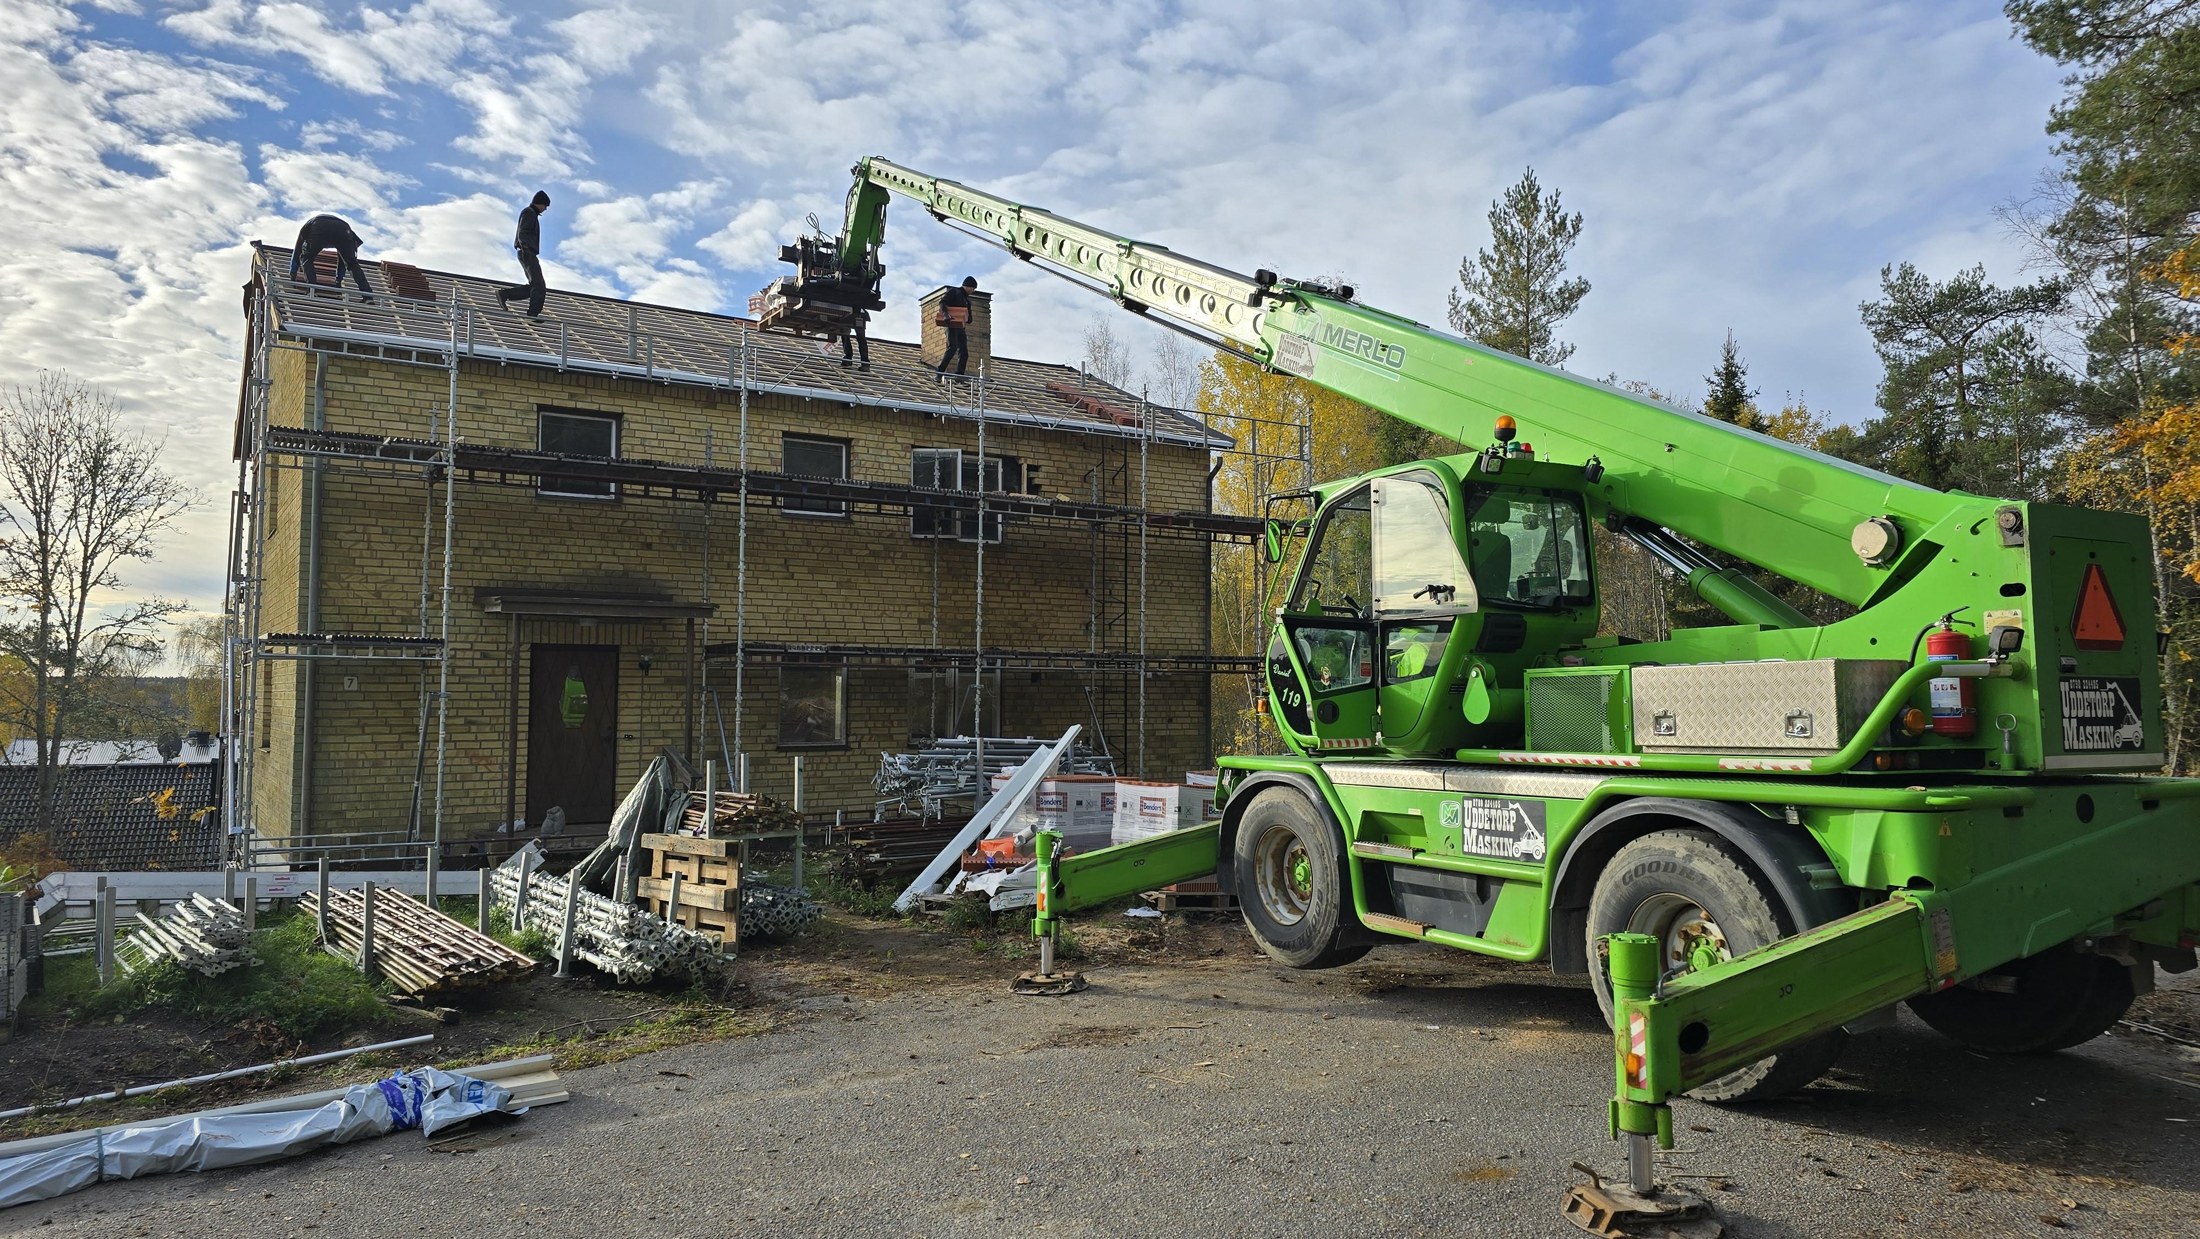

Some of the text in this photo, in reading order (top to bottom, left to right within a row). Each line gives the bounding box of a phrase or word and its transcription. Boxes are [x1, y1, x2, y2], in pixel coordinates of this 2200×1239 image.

[1323, 323, 1406, 370] MERLO
[347, 678, 355, 689] 7
[1282, 687, 1301, 708] 119
[2060, 681, 2115, 718] UDDETORP
[2062, 718, 2115, 750] MASKIN
[1040, 795, 1062, 806] Benders
[1143, 802, 1162, 812] Benders
[1463, 799, 1517, 832] UDDETORP
[1463, 827, 1513, 857] MASKIN
